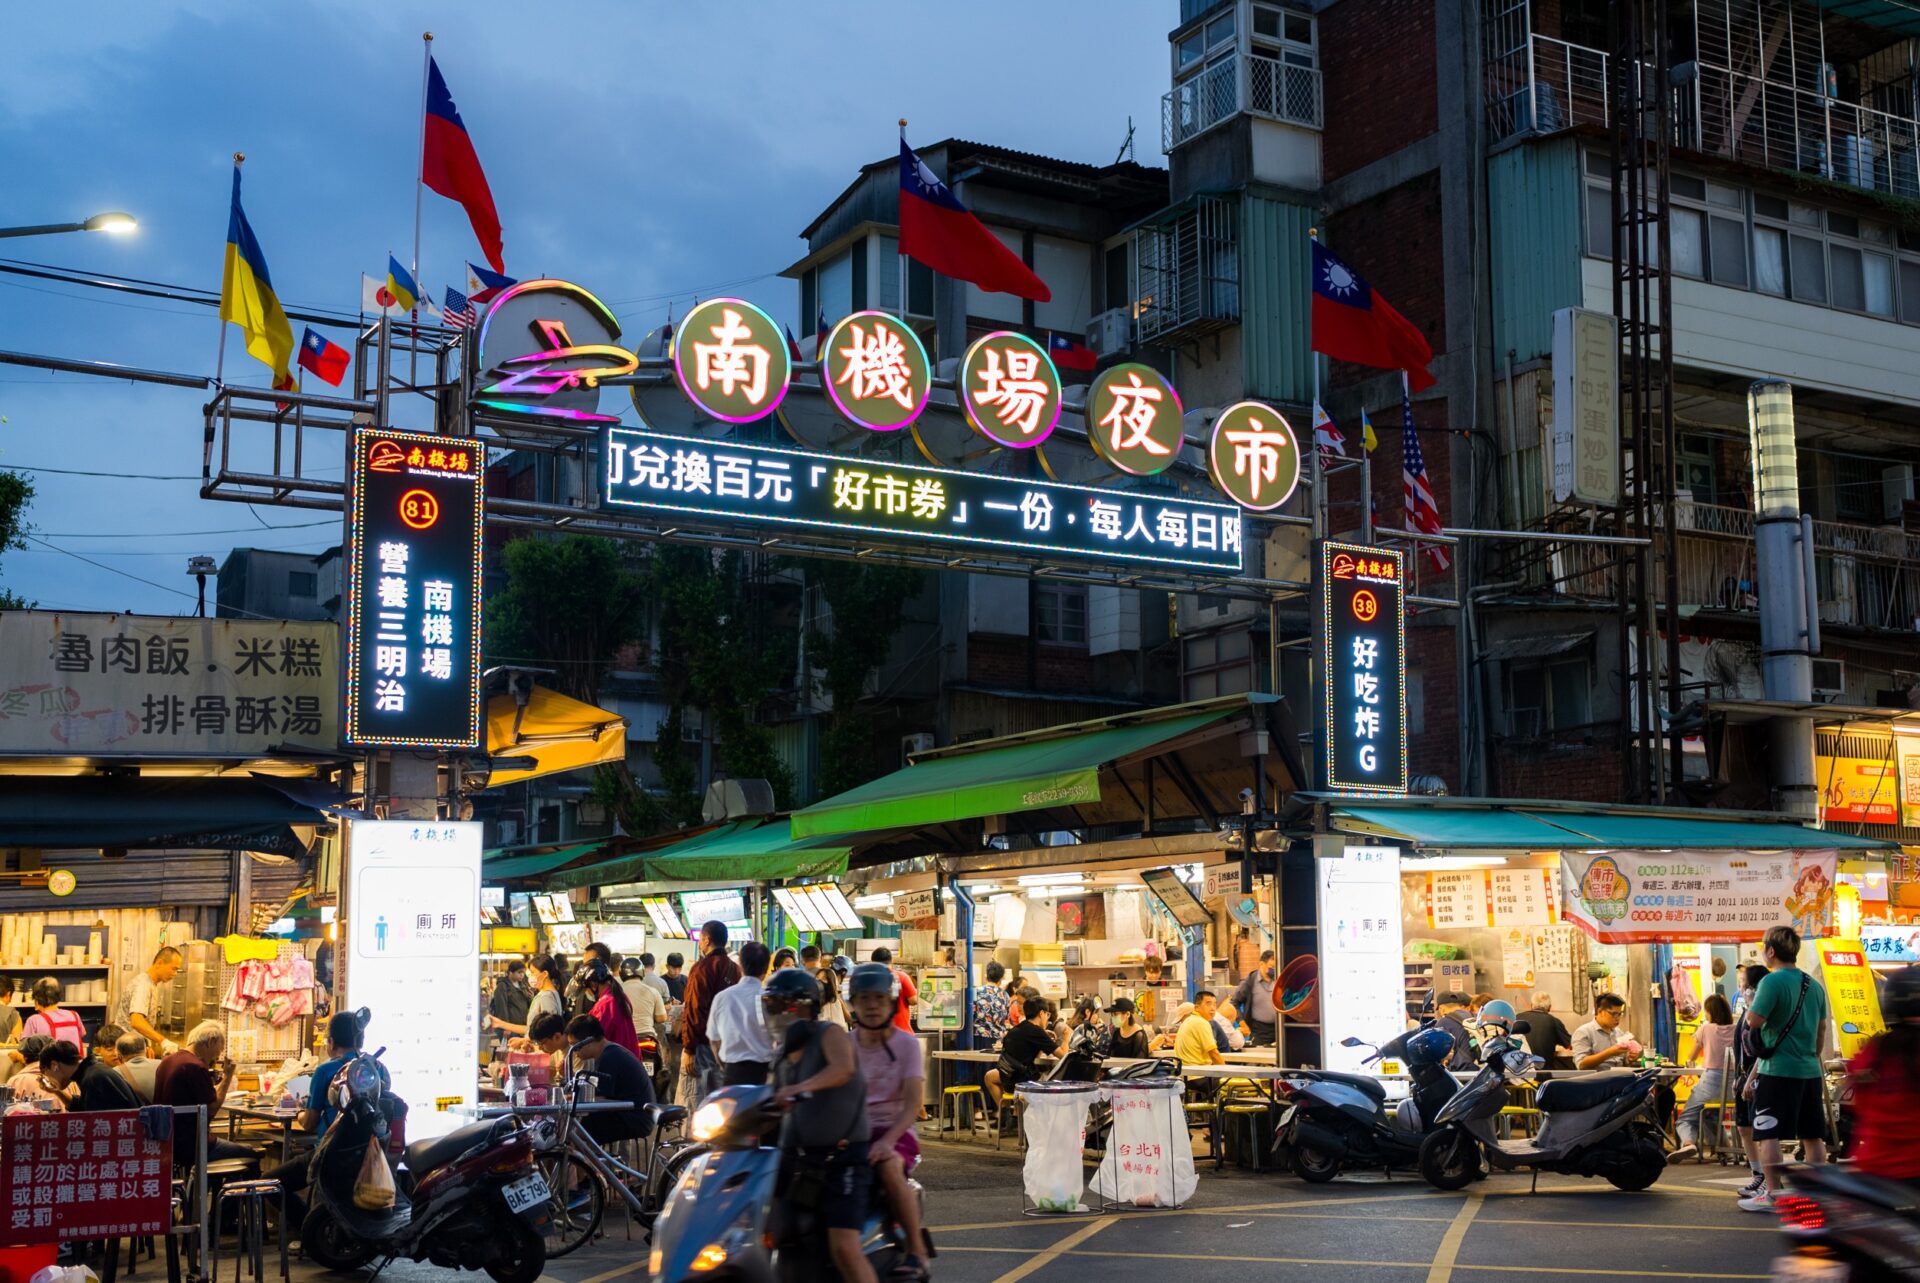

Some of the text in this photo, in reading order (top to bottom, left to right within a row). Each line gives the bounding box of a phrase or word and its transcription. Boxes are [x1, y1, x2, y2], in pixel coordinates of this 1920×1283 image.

[693, 308, 1287, 501] 南機場夜市
[407, 447, 469, 472] 南機場
[406, 500, 433, 520] 81
[1356, 598, 1374, 614] 38
[376, 542, 409, 713] 營養三明治
[421, 580, 454, 680] 南機場
[141, 693, 323, 736] 排骨酥湯
[1352, 636, 1380, 772] 好吃炸G
[1696, 897, 1713, 907] 10/4
[1717, 897, 1737, 907] 10/11
[416, 913, 457, 930] 廁所
[1665, 910, 1693, 922] 每週六
[1695, 913, 1712, 922] 10/7
[1716, 913, 1736, 922] 10/14
[1739, 913, 1758, 922] 10/21
[1761, 912, 1780, 922] 10/28
[14, 1117, 142, 1141] 此路段為紅
[13, 1139, 162, 1162] 禁止停車區域
[12, 1158, 161, 1185] 請勿於此處停車
[11, 1179, 161, 1207] 或設攤營業以免
[507, 1180, 548, 1209] BAE-790
[11, 1206, 64, 1230] 受罰。
